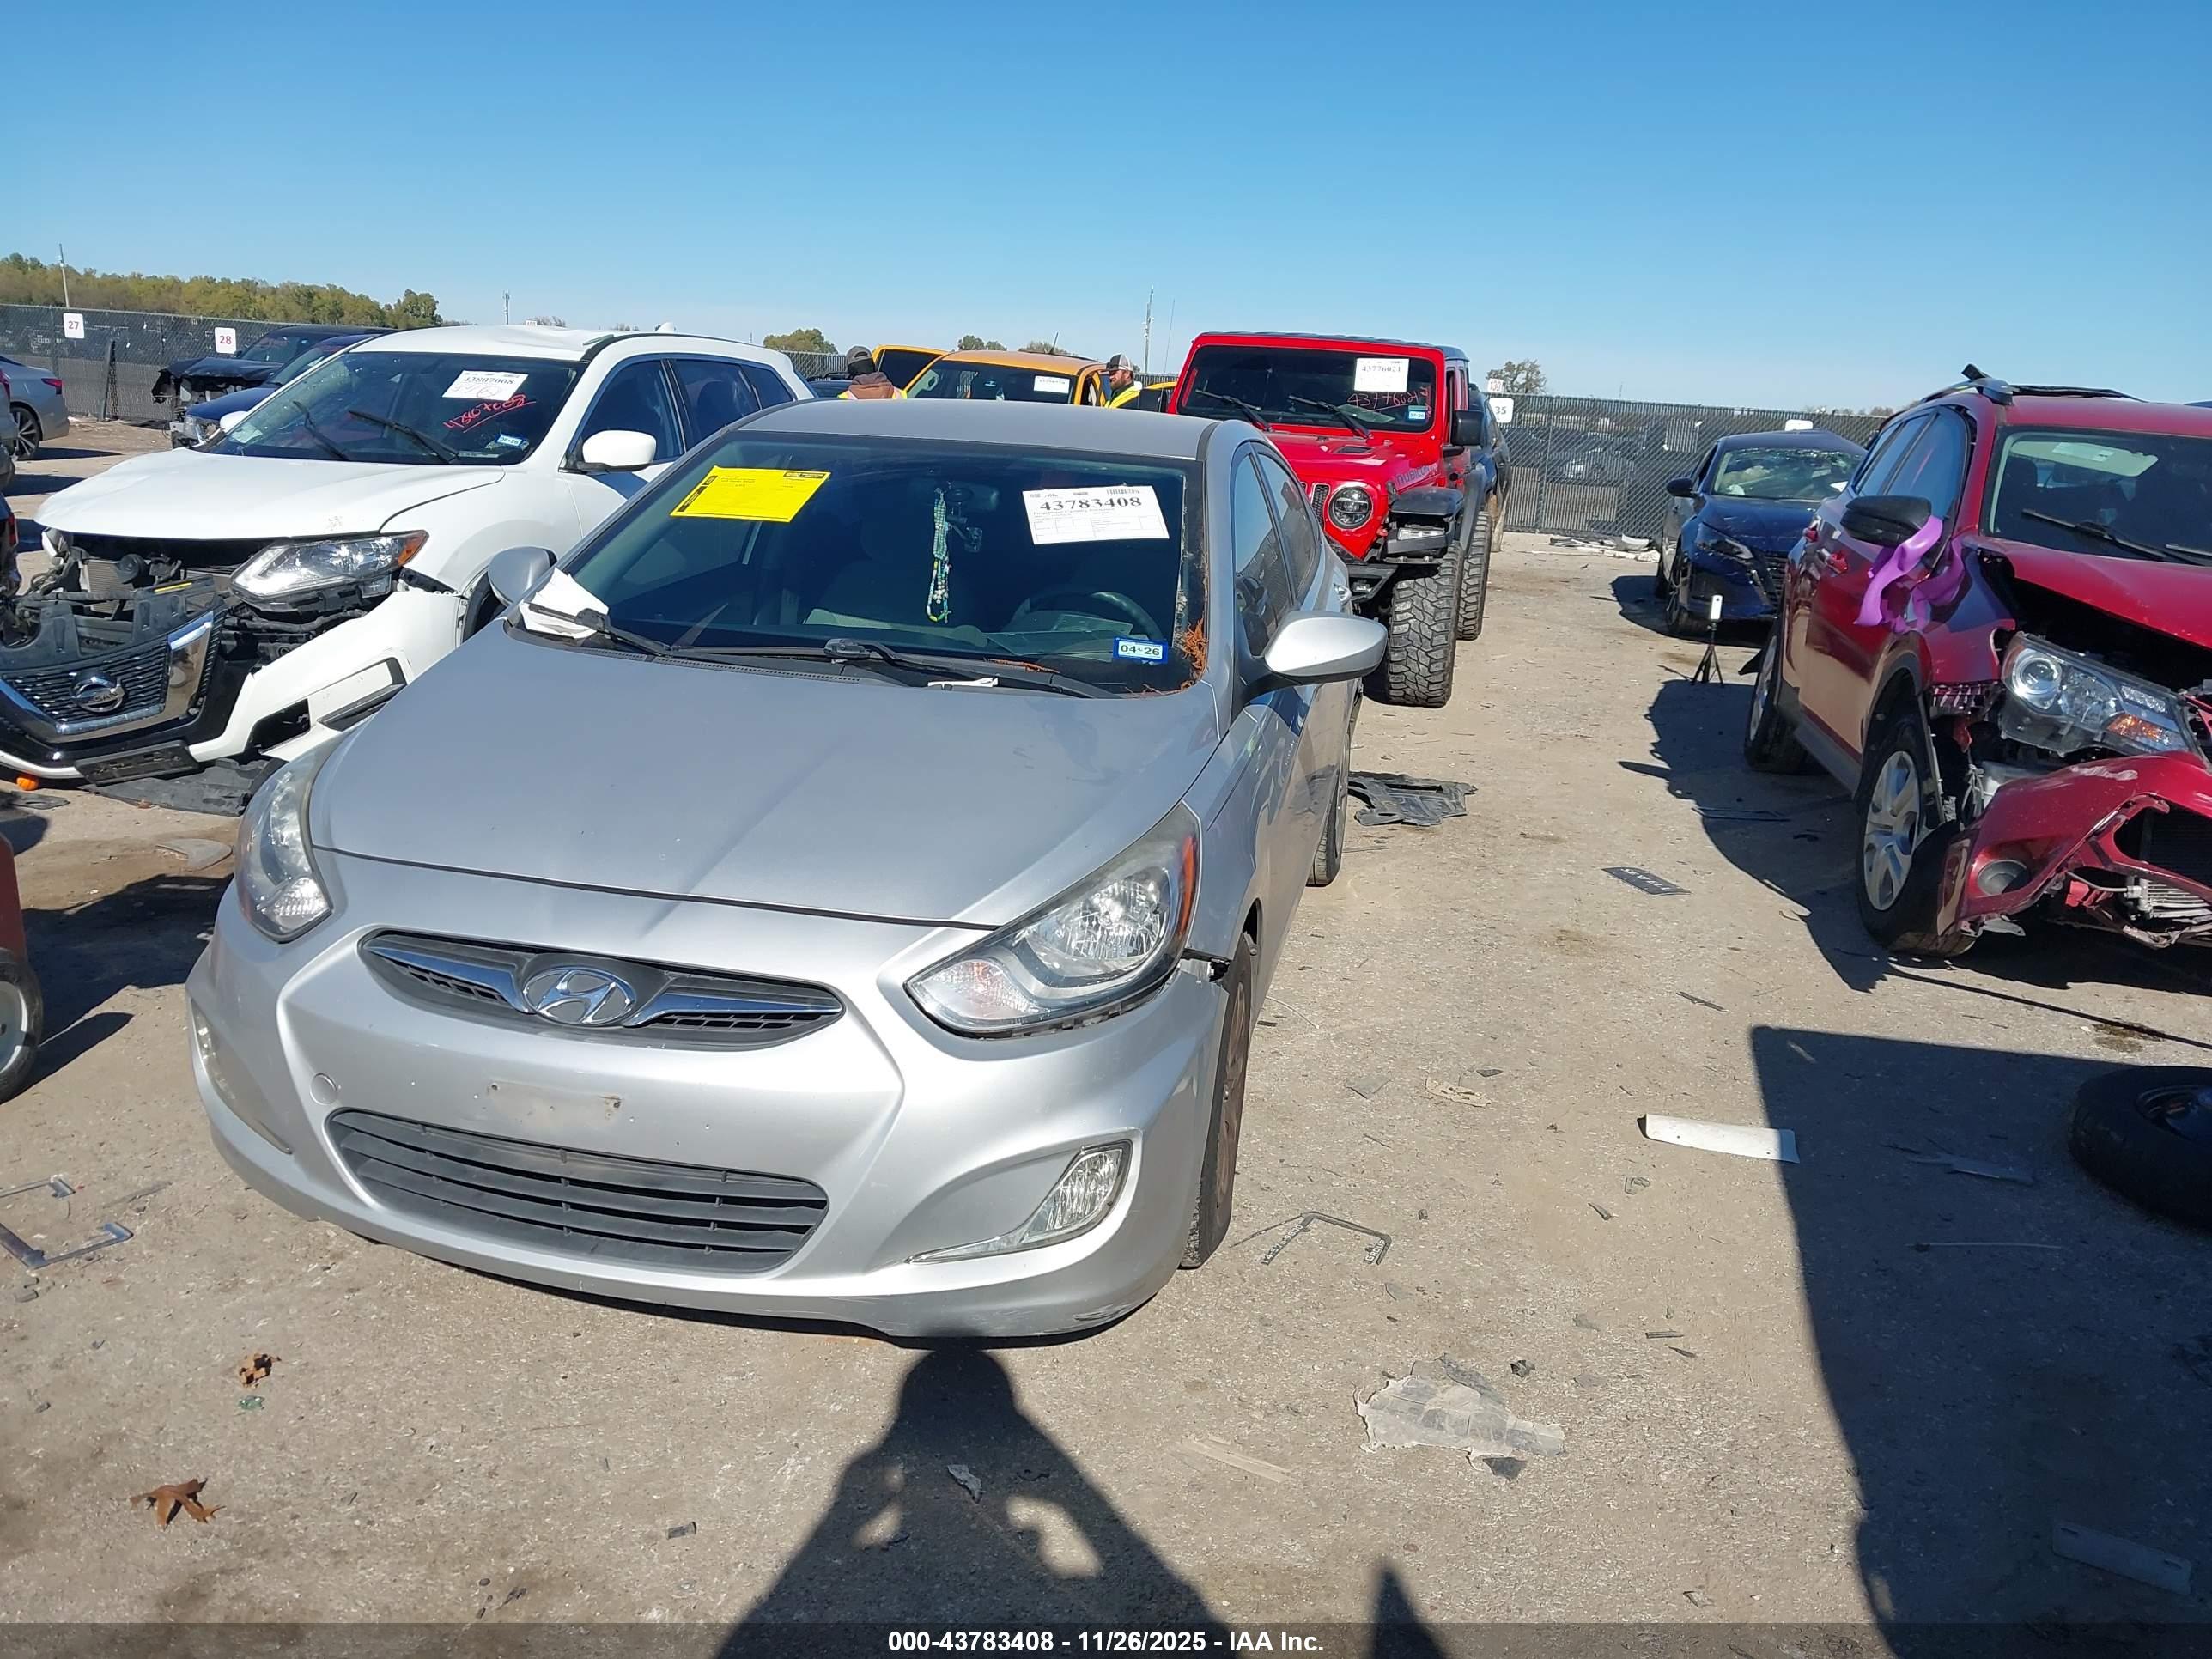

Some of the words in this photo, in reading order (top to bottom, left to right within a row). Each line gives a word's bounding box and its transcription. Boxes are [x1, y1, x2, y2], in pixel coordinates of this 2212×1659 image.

[68, 320, 80, 331] 27
[219, 335, 232, 345] 28
[1039, 496, 1143, 512] 43783408
